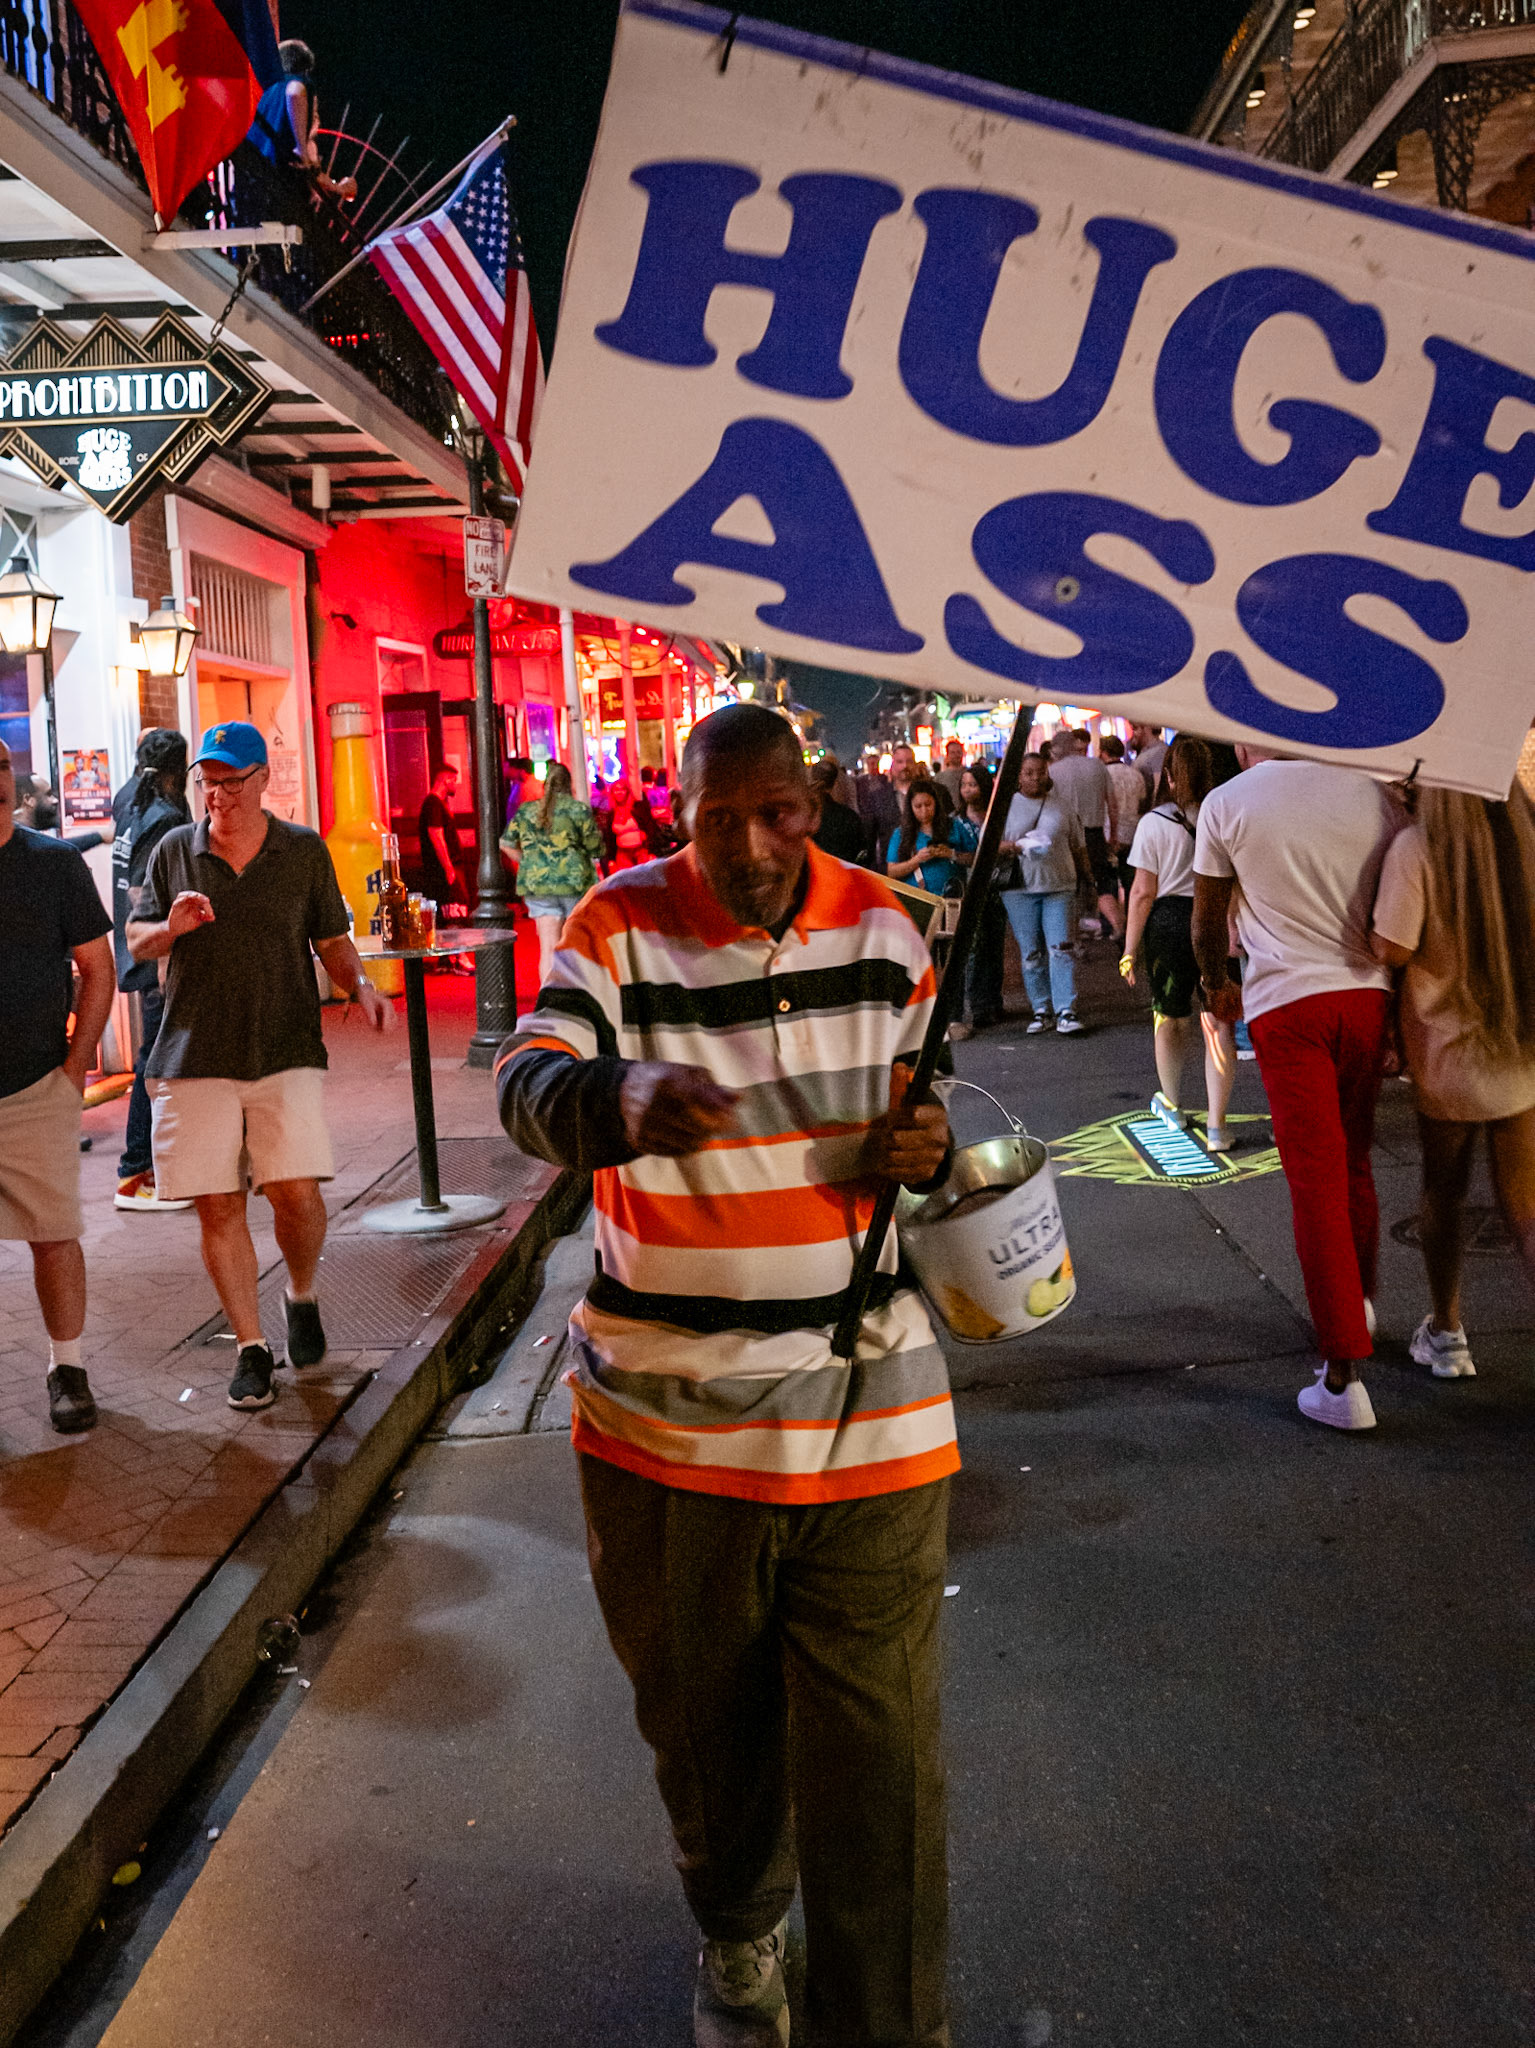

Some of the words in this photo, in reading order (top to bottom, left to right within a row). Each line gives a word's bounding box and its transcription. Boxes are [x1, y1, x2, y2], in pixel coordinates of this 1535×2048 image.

[595, 161, 1535, 572] HUGE
[0, 370, 208, 419] PROHIBITION
[77, 427, 132, 453] HUGE
[466, 520, 480, 537] NO
[475, 544, 498, 558] FIRE
[473, 561, 498, 579] LANE
[569, 416, 1468, 749] ASS
